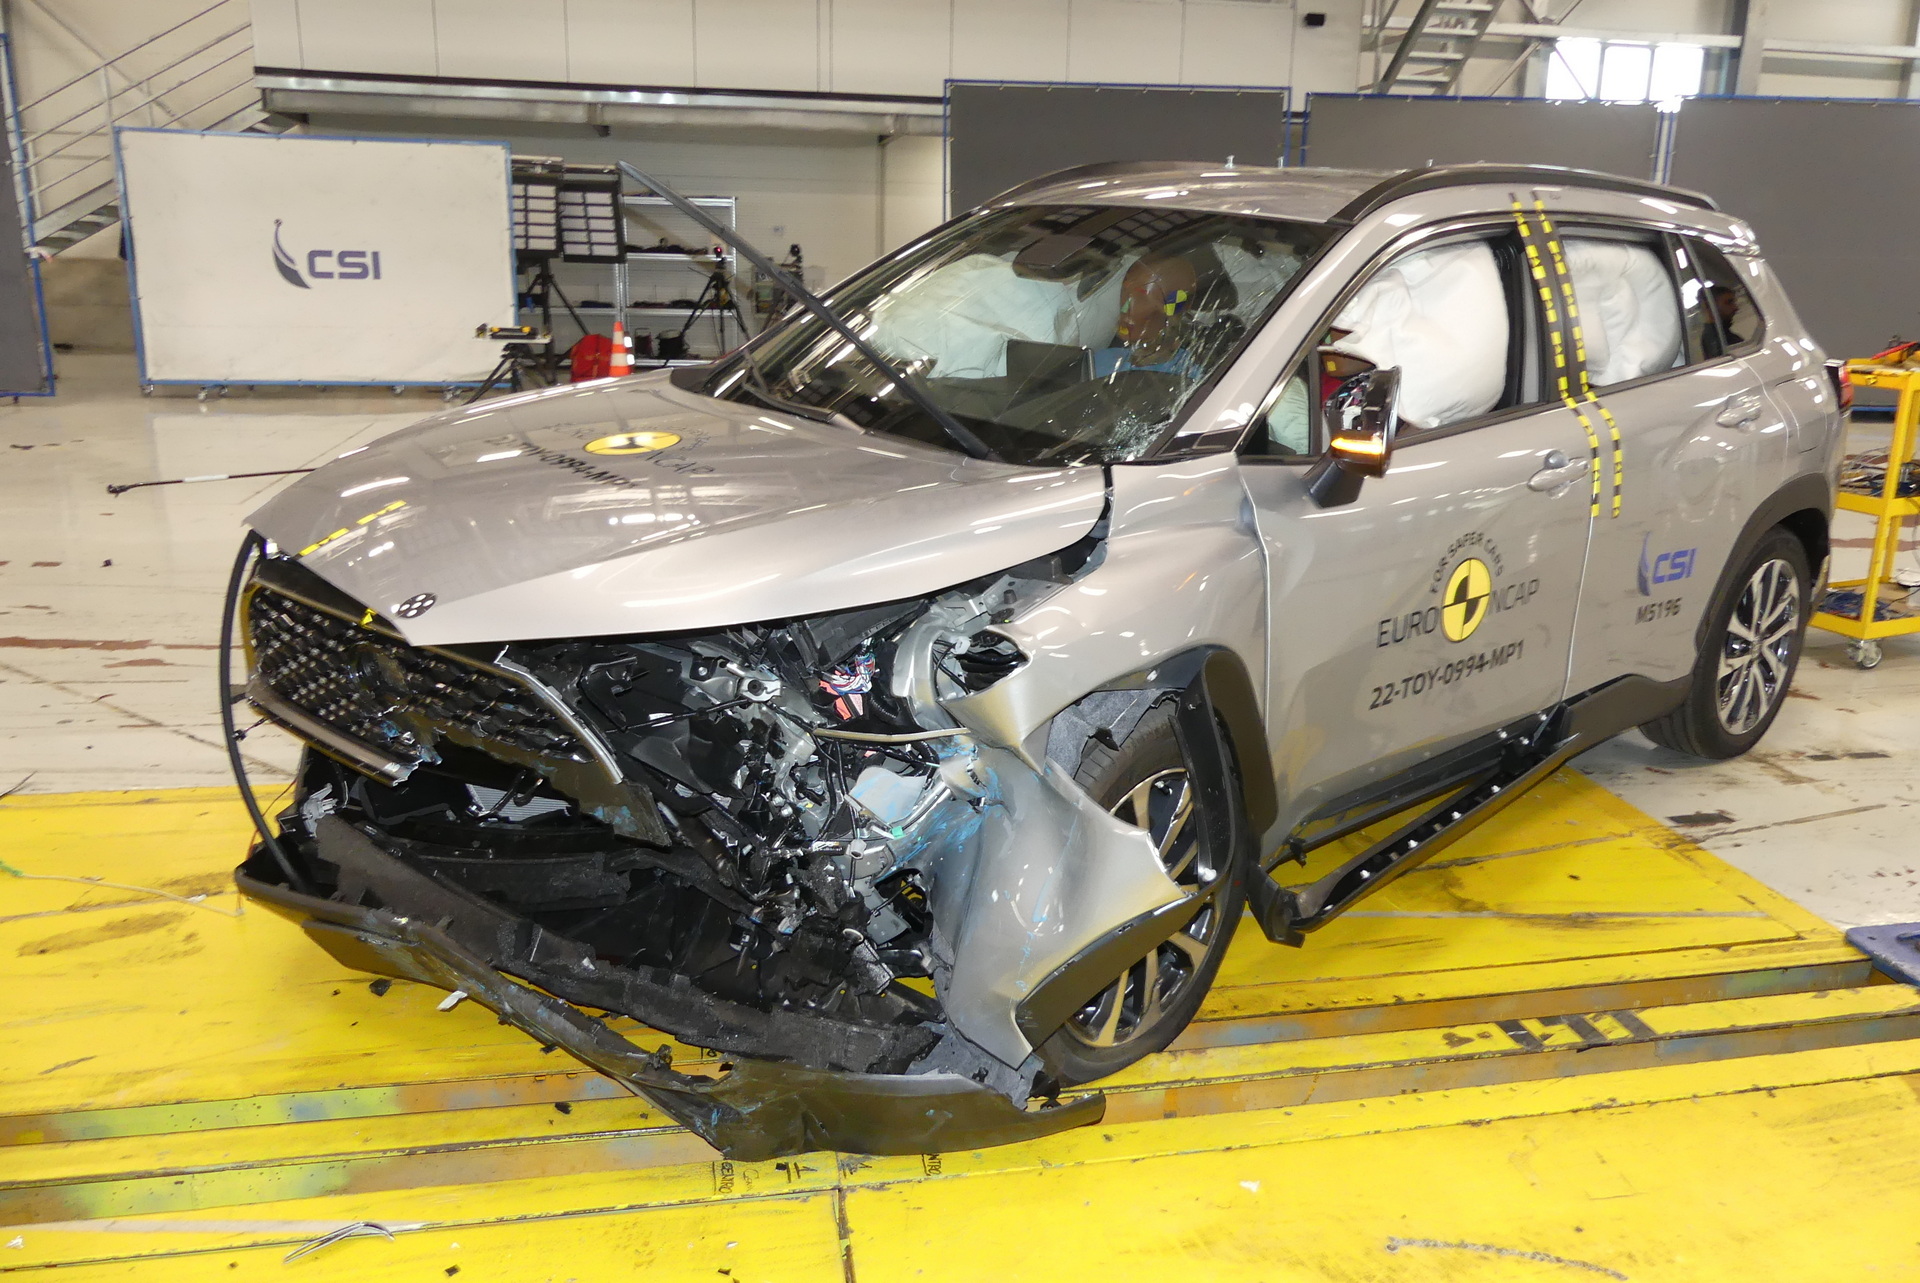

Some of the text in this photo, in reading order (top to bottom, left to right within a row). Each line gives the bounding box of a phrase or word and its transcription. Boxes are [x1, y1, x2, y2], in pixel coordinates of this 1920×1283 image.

[307, 249, 382, 280] CSI
[1429, 556, 1449, 594] FOR
[1447, 531, 1484, 558] SAFER
[1653, 548, 1697, 584] CSI
[1376, 578, 1540, 649] EURO NCAP
[1368, 639, 1524, 711] 22-TOY-0994-MP1
